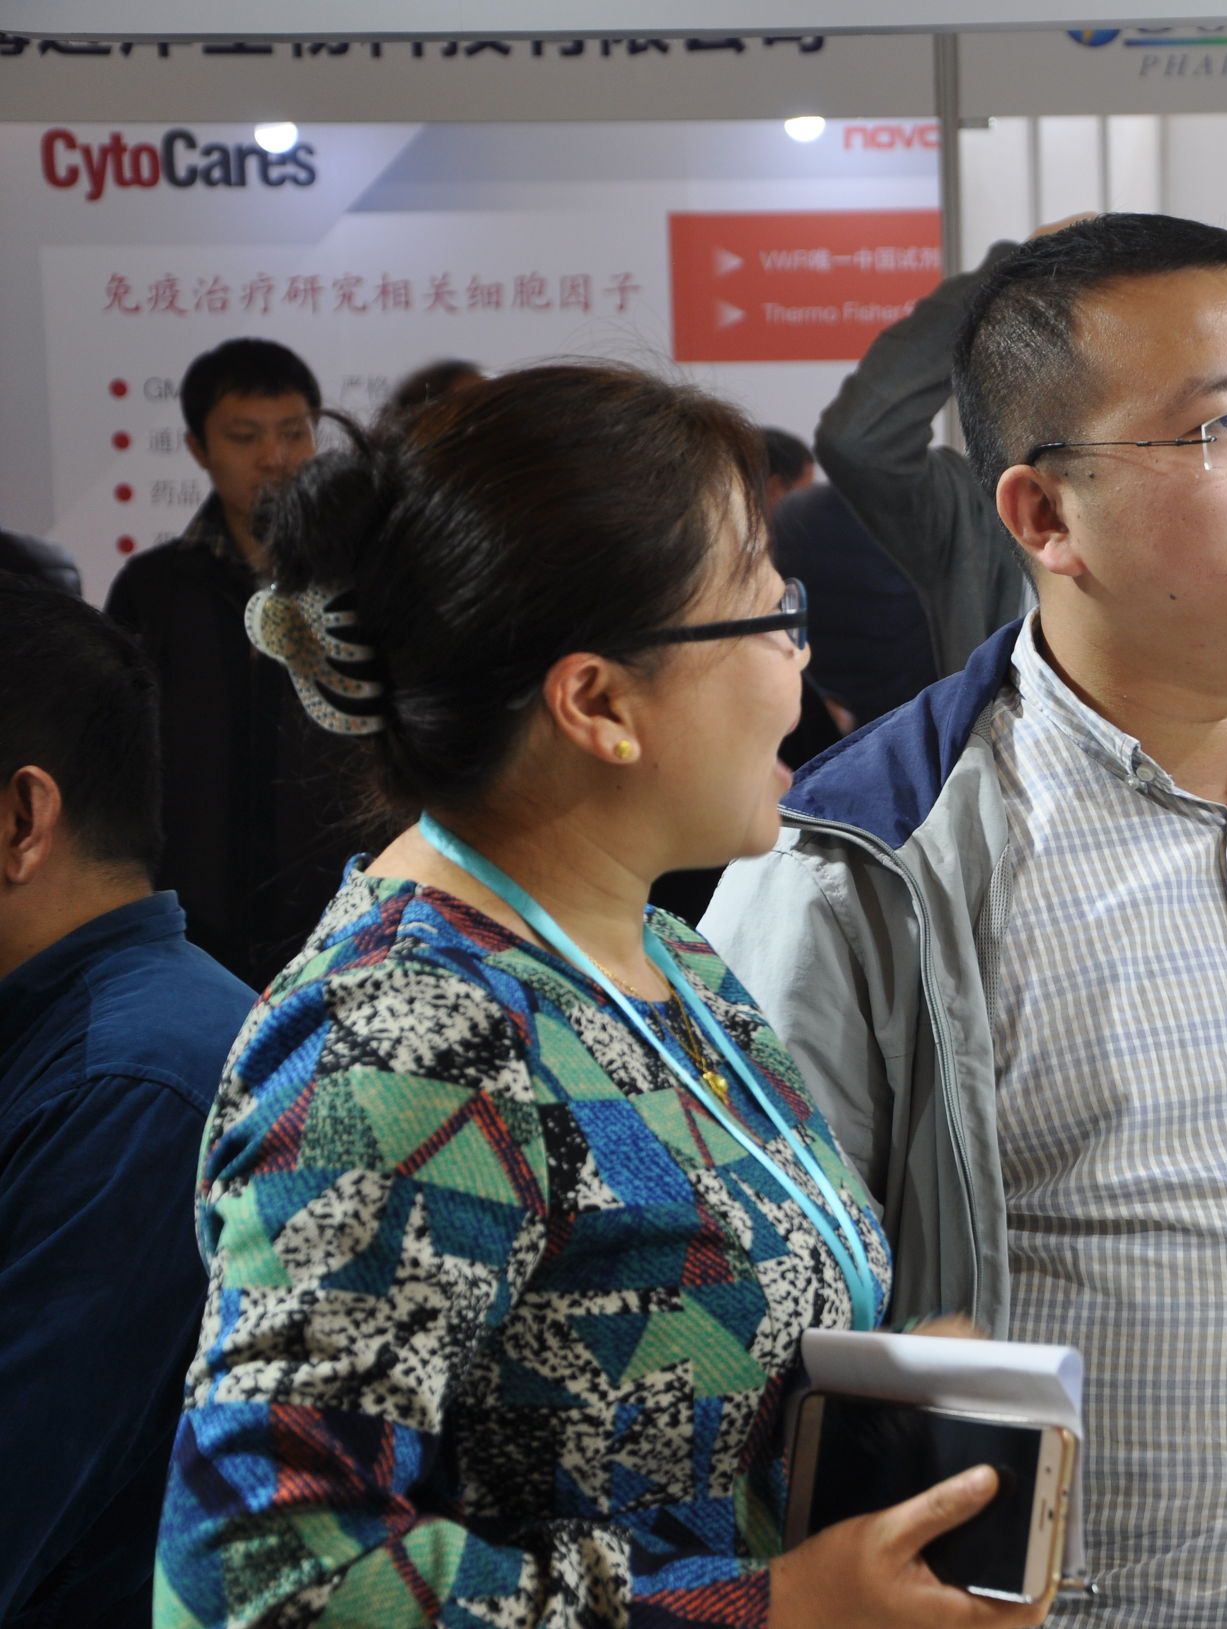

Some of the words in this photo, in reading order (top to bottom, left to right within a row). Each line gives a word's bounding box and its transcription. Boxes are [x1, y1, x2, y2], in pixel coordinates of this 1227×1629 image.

[41, 128, 316, 202] CytoCares
[102, 271, 643, 316] 免疫治疗研究相关细胞因子
